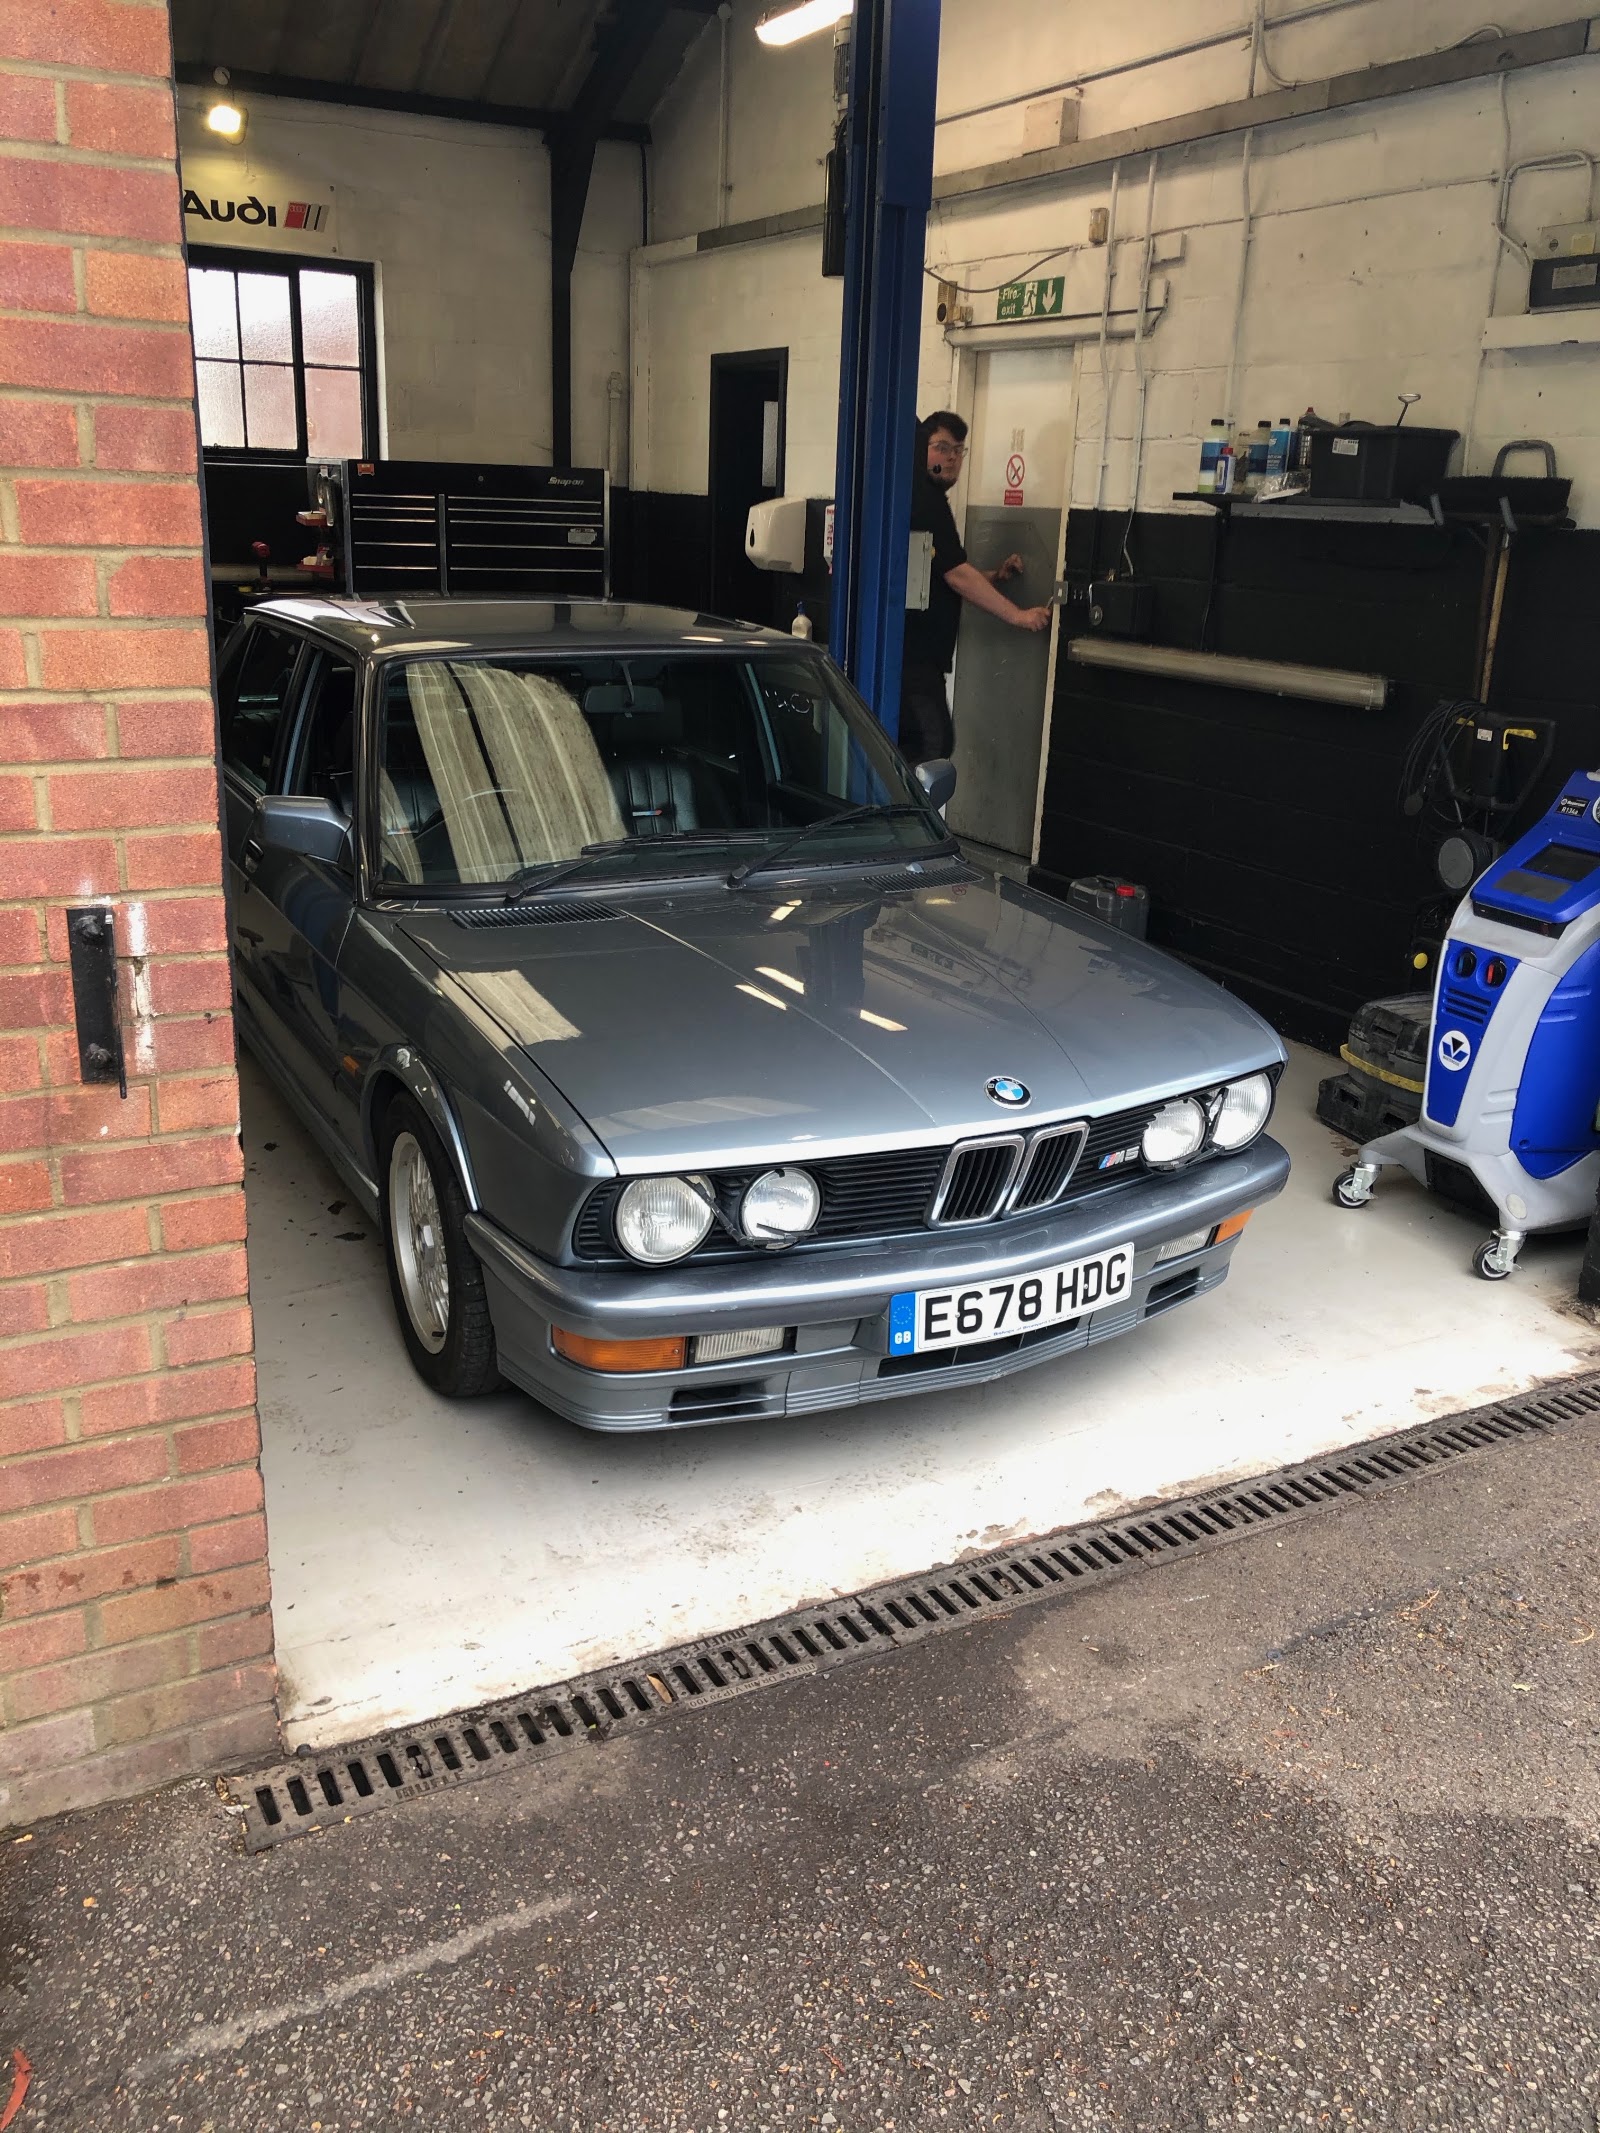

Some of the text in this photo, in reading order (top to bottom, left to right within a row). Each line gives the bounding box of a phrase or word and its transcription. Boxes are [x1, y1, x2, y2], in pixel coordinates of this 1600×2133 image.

[1002, 286, 1018, 300] Fire
[1001, 303, 1016, 315] exit
[1104, 1146, 1140, 1168] M5
[924, 1278, 1042, 1341] E678
[1056, 1252, 1127, 1314] HDG
[895, 1331, 912, 1344] GB
